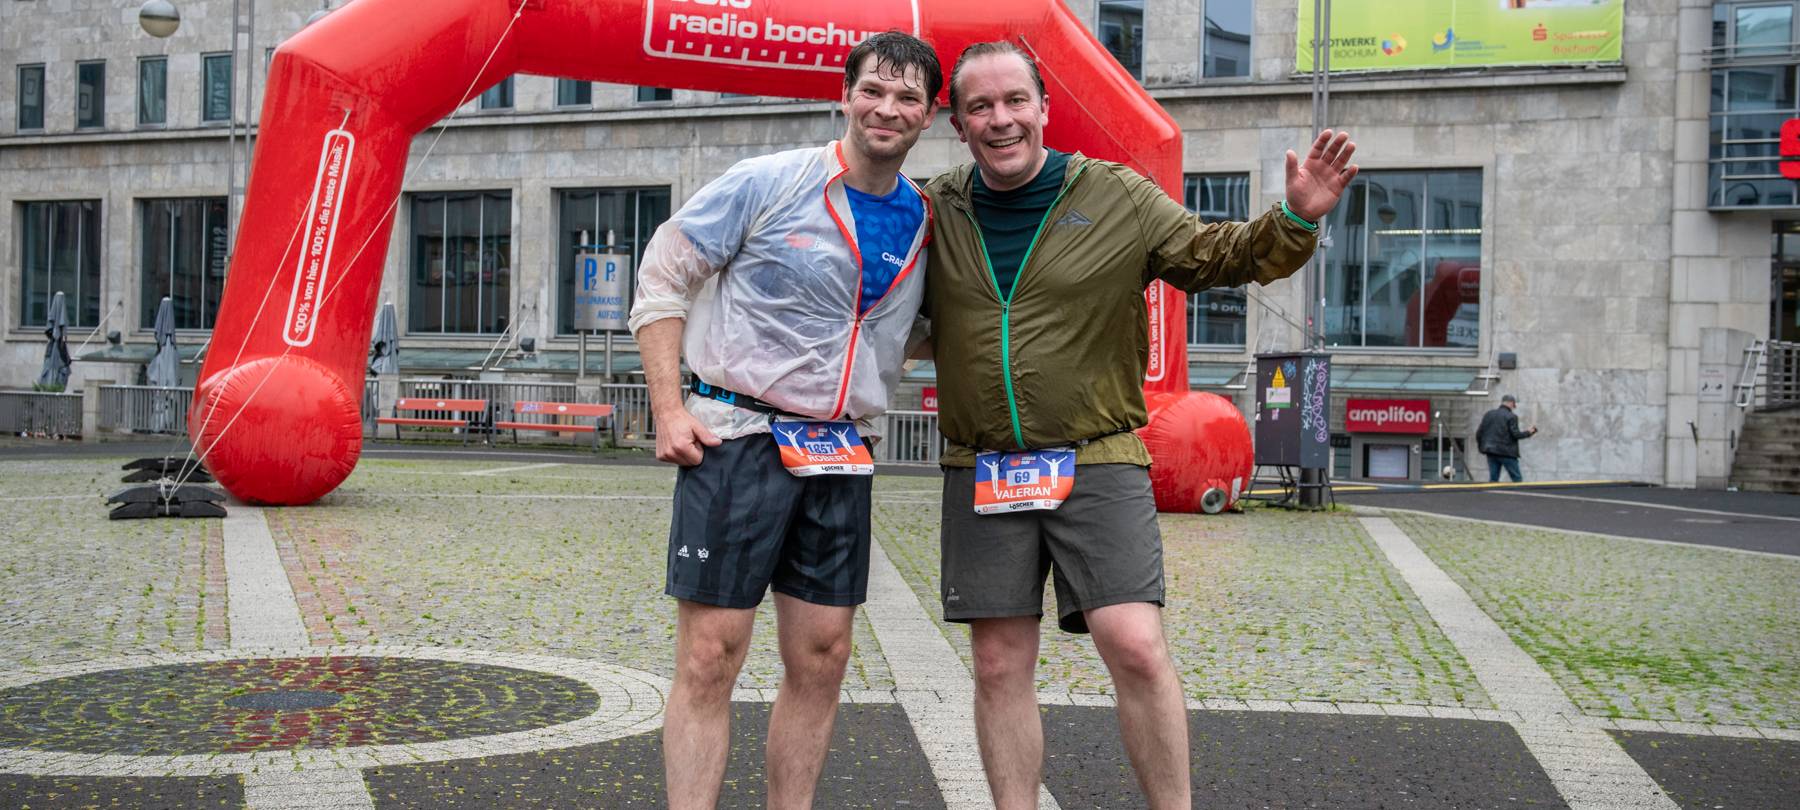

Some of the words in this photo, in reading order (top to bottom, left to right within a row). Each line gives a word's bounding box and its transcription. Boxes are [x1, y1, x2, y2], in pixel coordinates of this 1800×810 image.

[669, 13, 758, 39] radio
[764, 18, 884, 47] bochu
[1309, 37, 1377, 48] SADTWERKE
[1334, 48, 1377, 58] BOCHUM
[328, 143, 345, 178] Musik.
[322, 177, 337, 206] beste
[318, 205, 331, 226] die
[311, 225, 328, 256] 100%
[881, 251, 905, 267] CRAF
[303, 281, 315, 301] von
[294, 301, 310, 334] 100%
[1150, 343, 1159, 371] 100%
[1349, 406, 1427, 426] amplifon
[805, 443, 835, 454] 1857
[807, 455, 850, 463] ROBERT
[1014, 471, 1031, 483] 69
[996, 486, 1051, 499] VALERIAN
